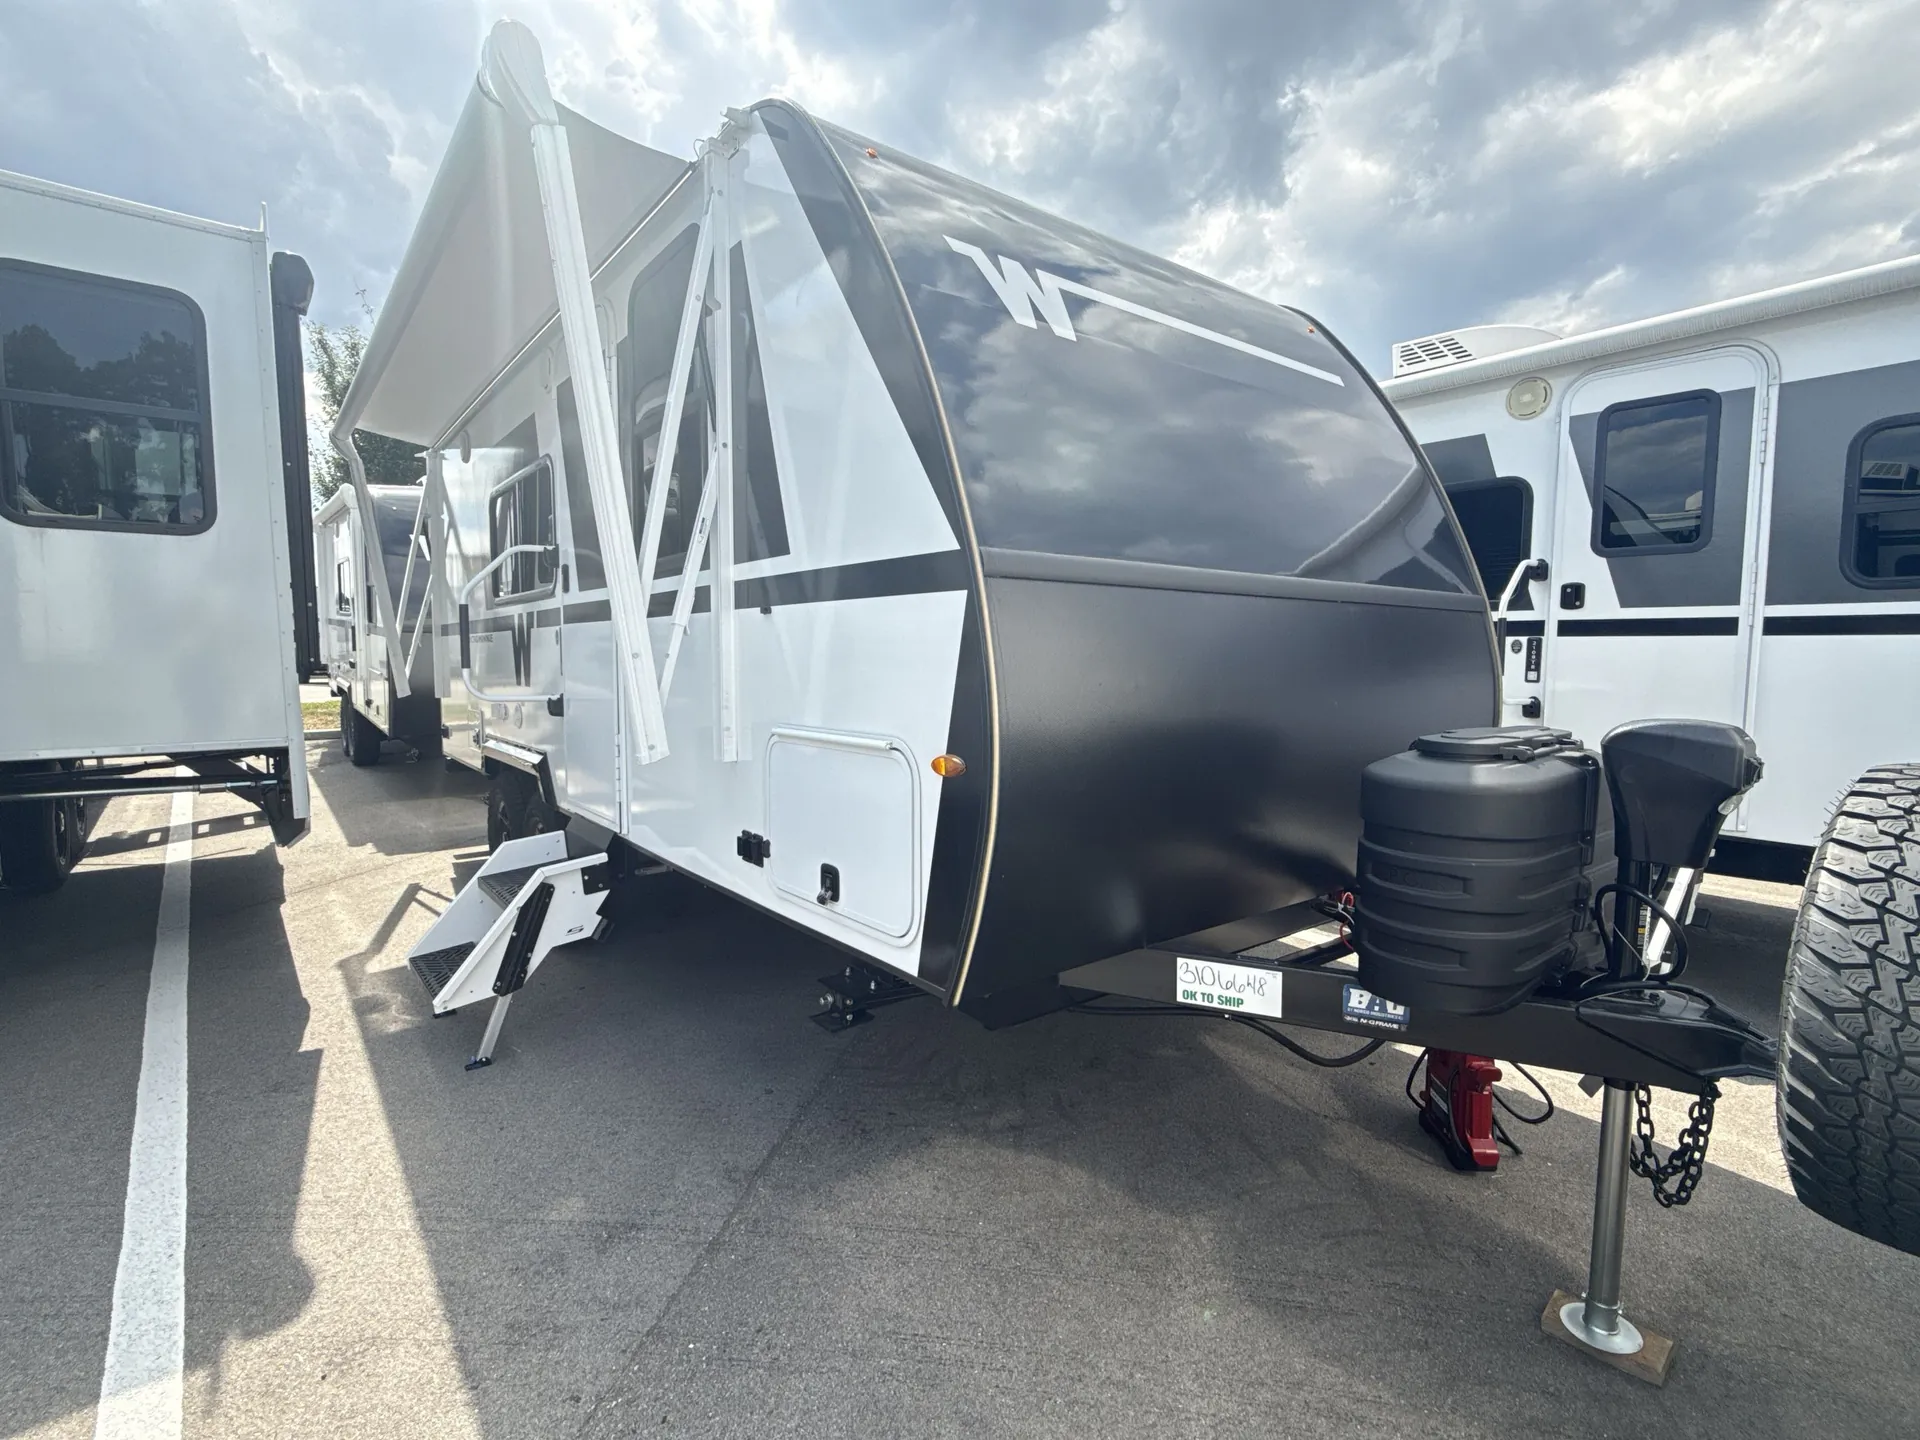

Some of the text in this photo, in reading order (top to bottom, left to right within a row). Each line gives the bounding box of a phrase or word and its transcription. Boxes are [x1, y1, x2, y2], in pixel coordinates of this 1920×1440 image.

[1182, 989, 1244, 1008] OK TO SHIP
